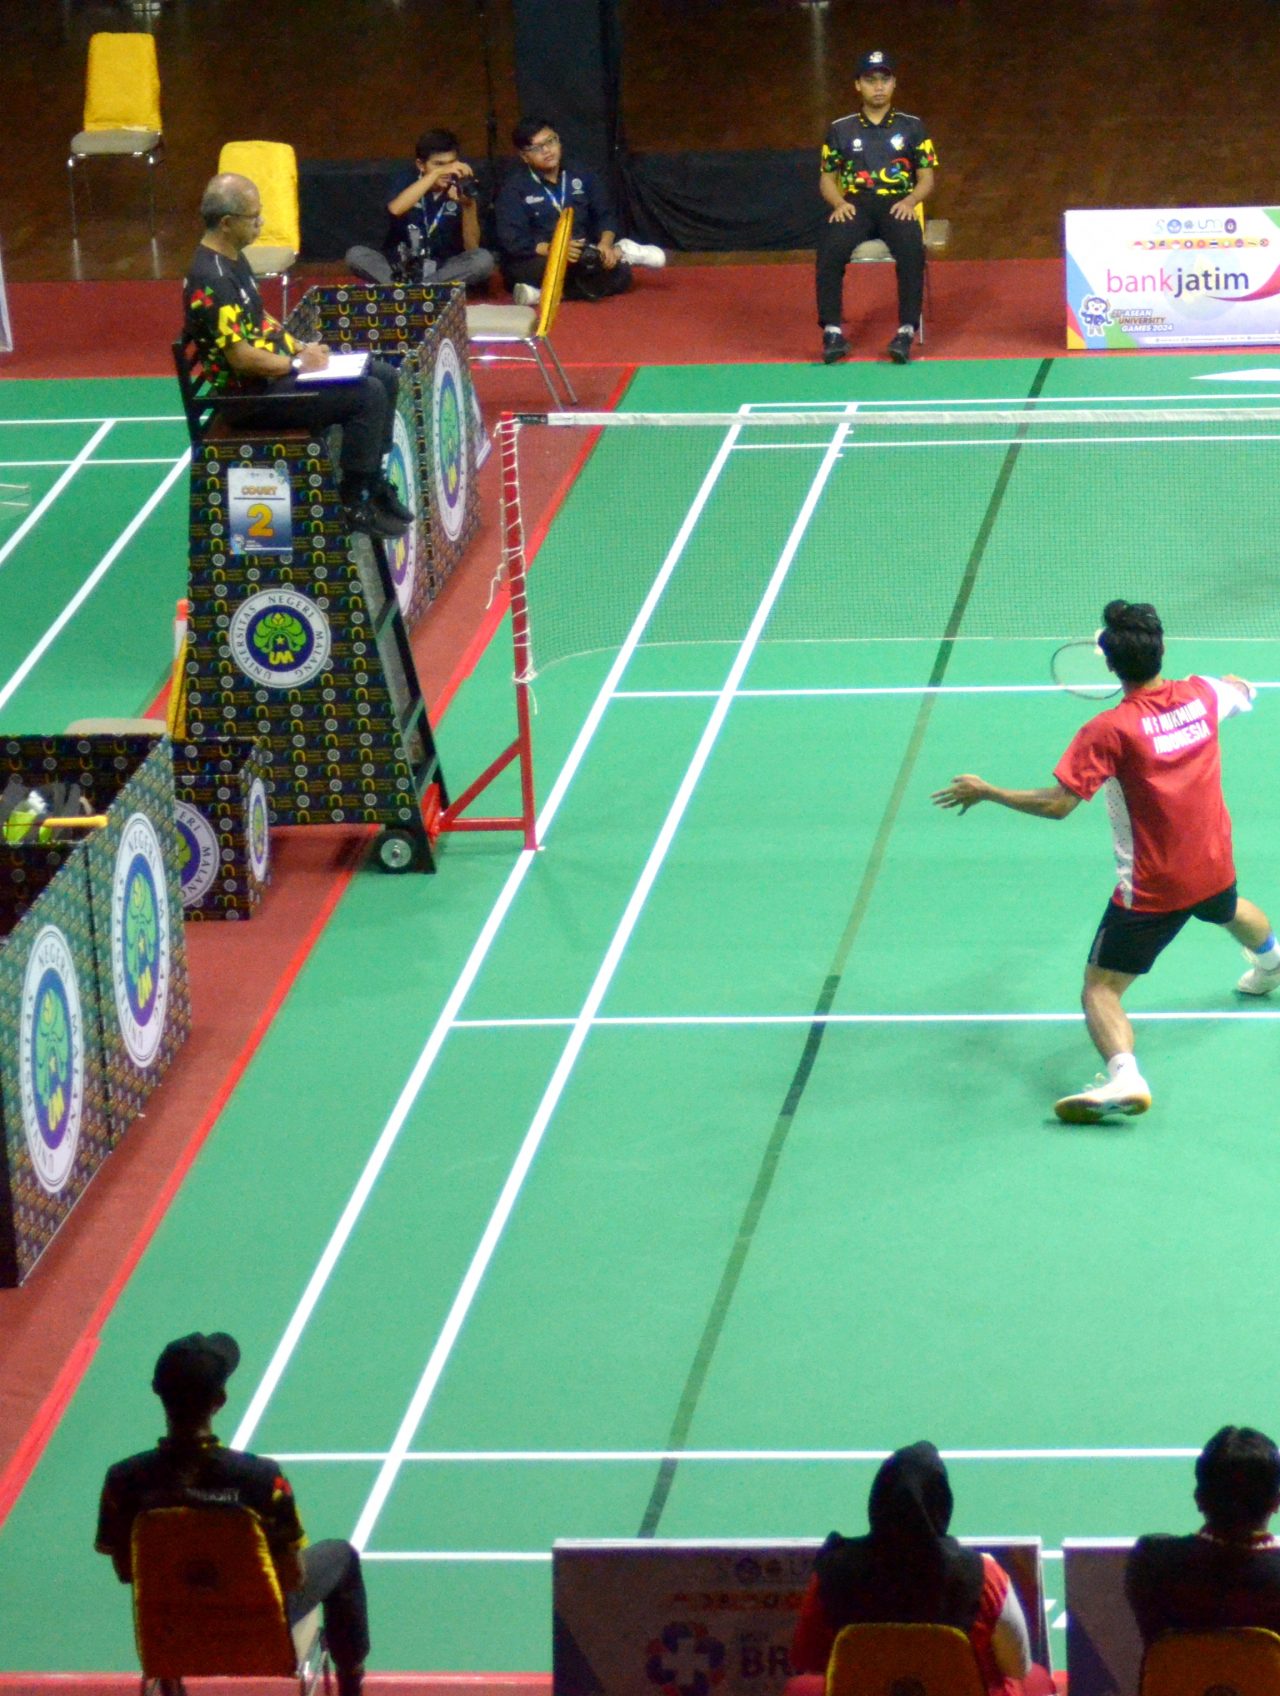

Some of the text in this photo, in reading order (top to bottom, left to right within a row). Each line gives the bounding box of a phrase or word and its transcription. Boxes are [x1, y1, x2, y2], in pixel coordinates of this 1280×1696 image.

[1124, 309, 1152, 317] ASEAN
[1122, 324, 1151, 332] GAMES
[241, 485, 278, 496] COURT
[247, 503, 275, 538] 2
[234, 595, 325, 680] UNIVERSITAS NEGERI MALANG
[178, 810, 201, 832] ERI
